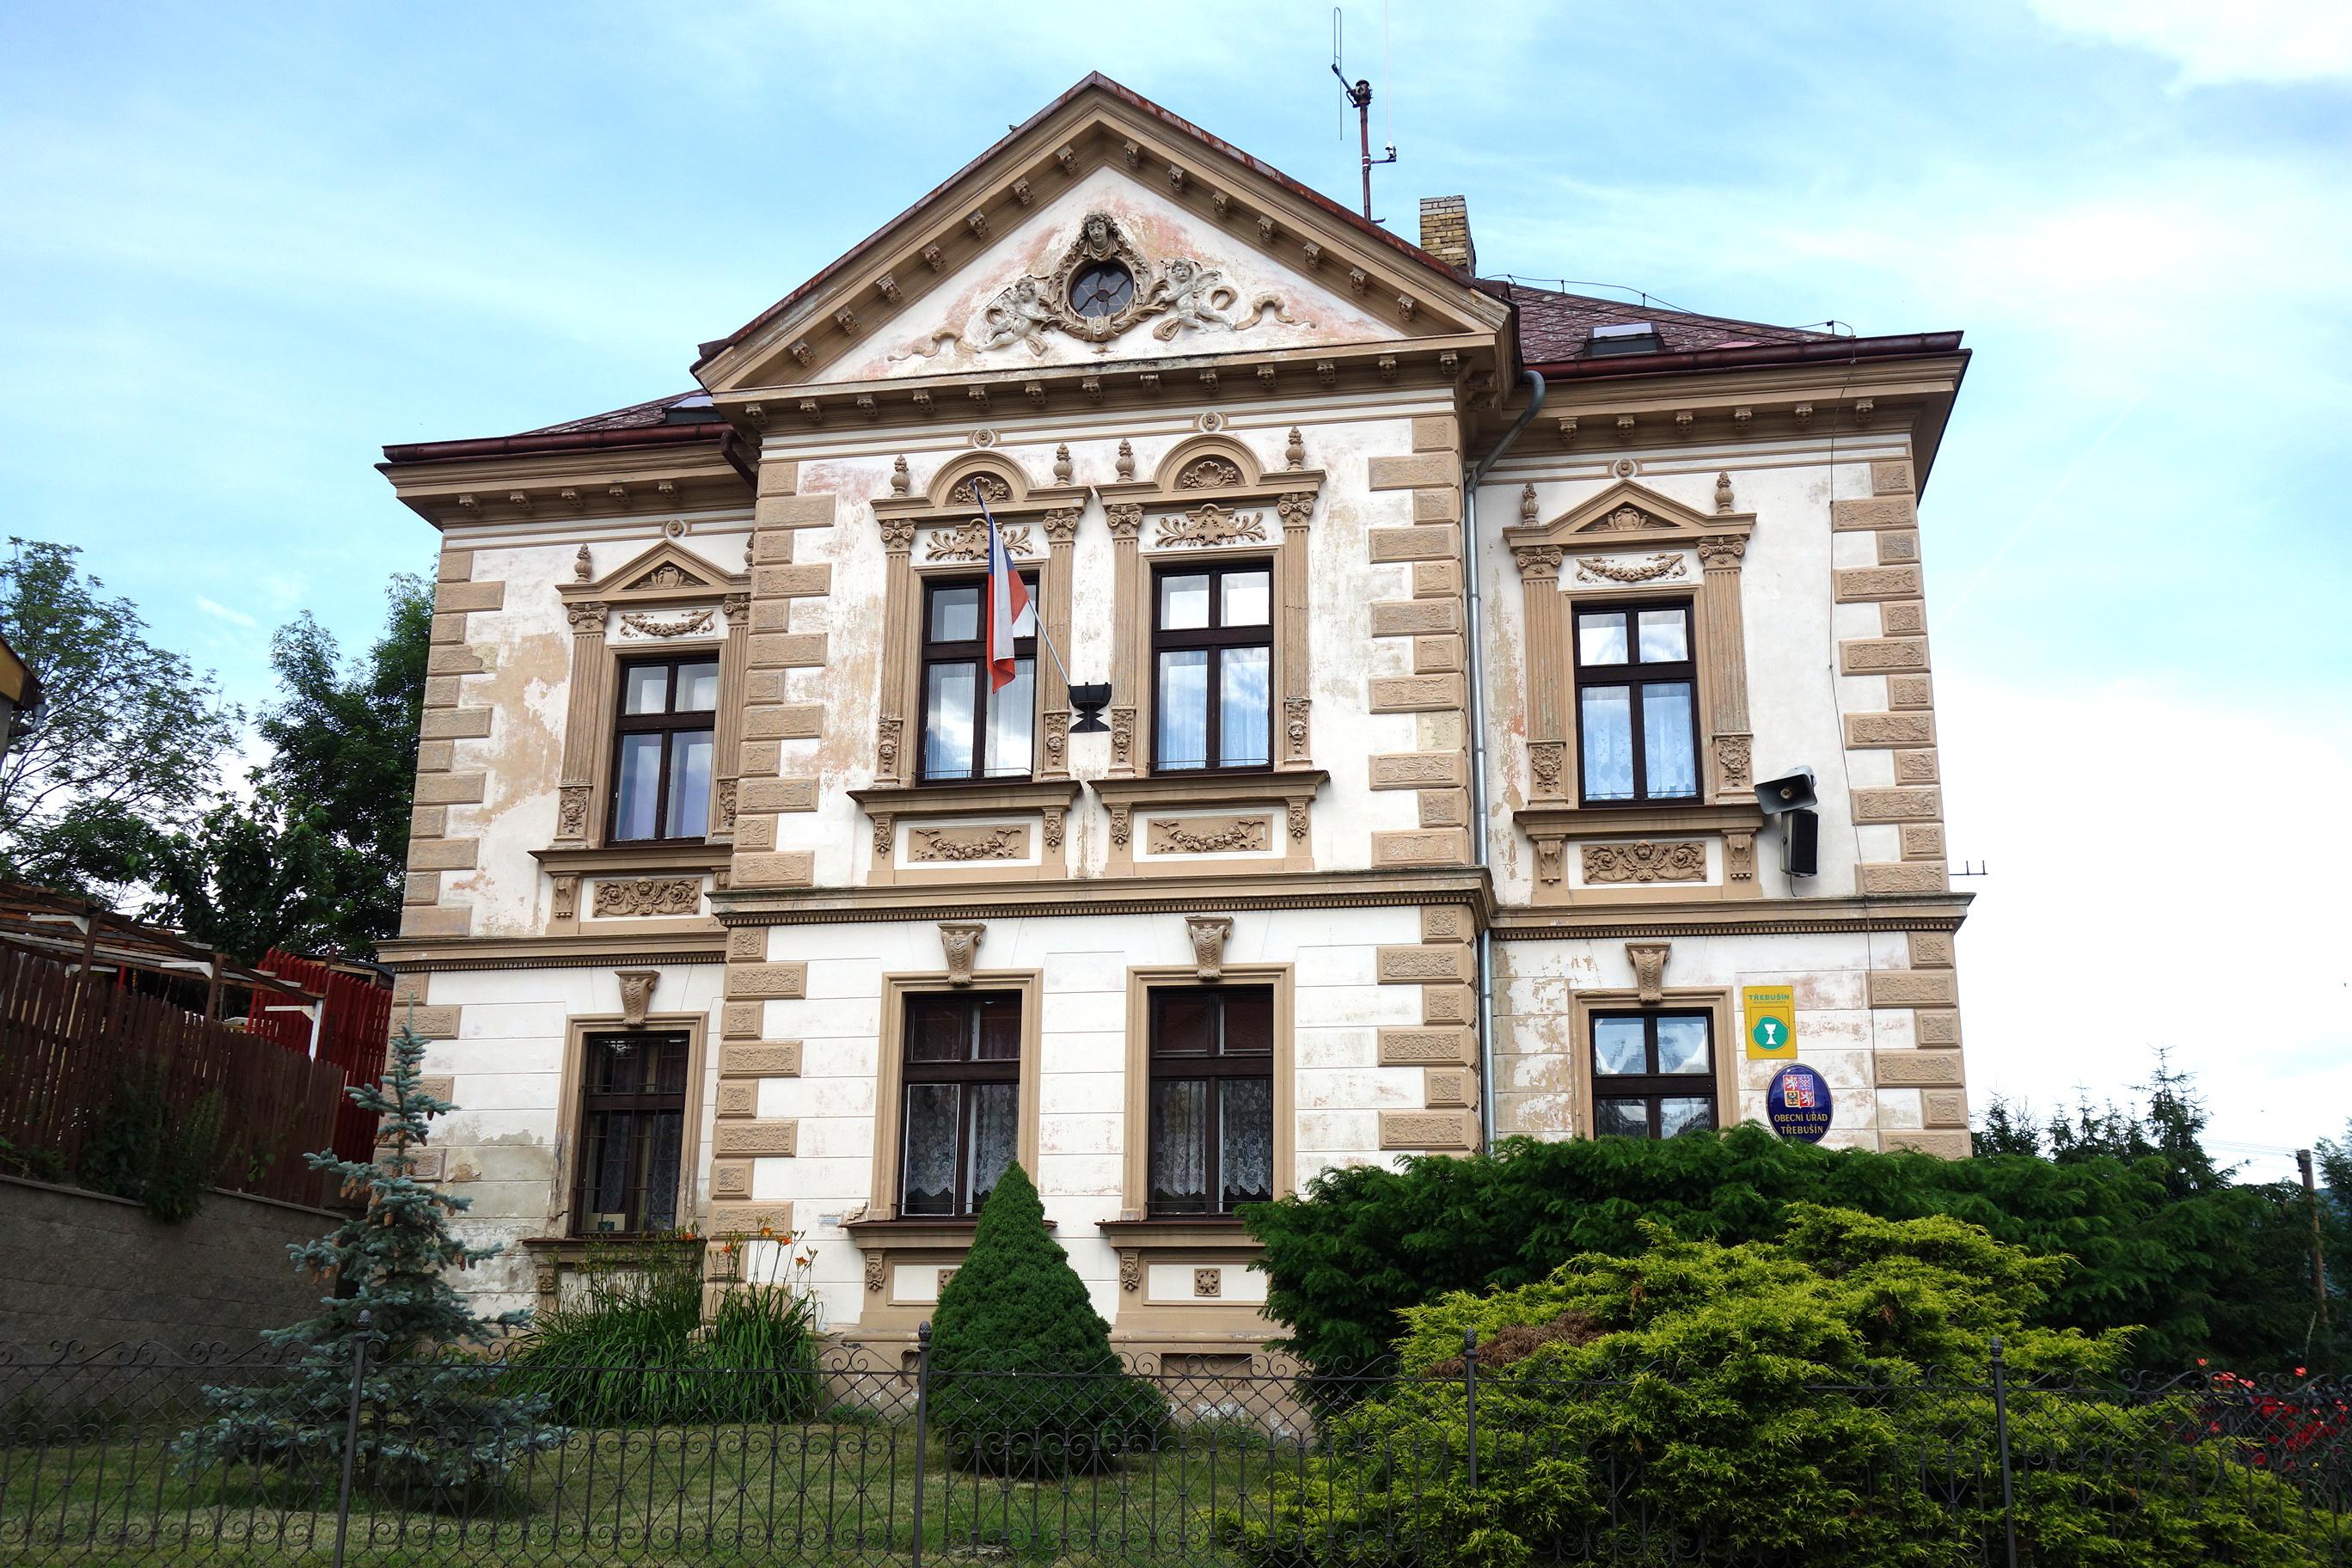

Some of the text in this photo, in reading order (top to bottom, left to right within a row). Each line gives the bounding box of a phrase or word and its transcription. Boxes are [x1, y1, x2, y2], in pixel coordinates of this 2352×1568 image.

[1773, 1111, 1828, 1122] OBECNÍ ÚŘAD
[1780, 1124, 1823, 1135] TŘEBUŠÍN
